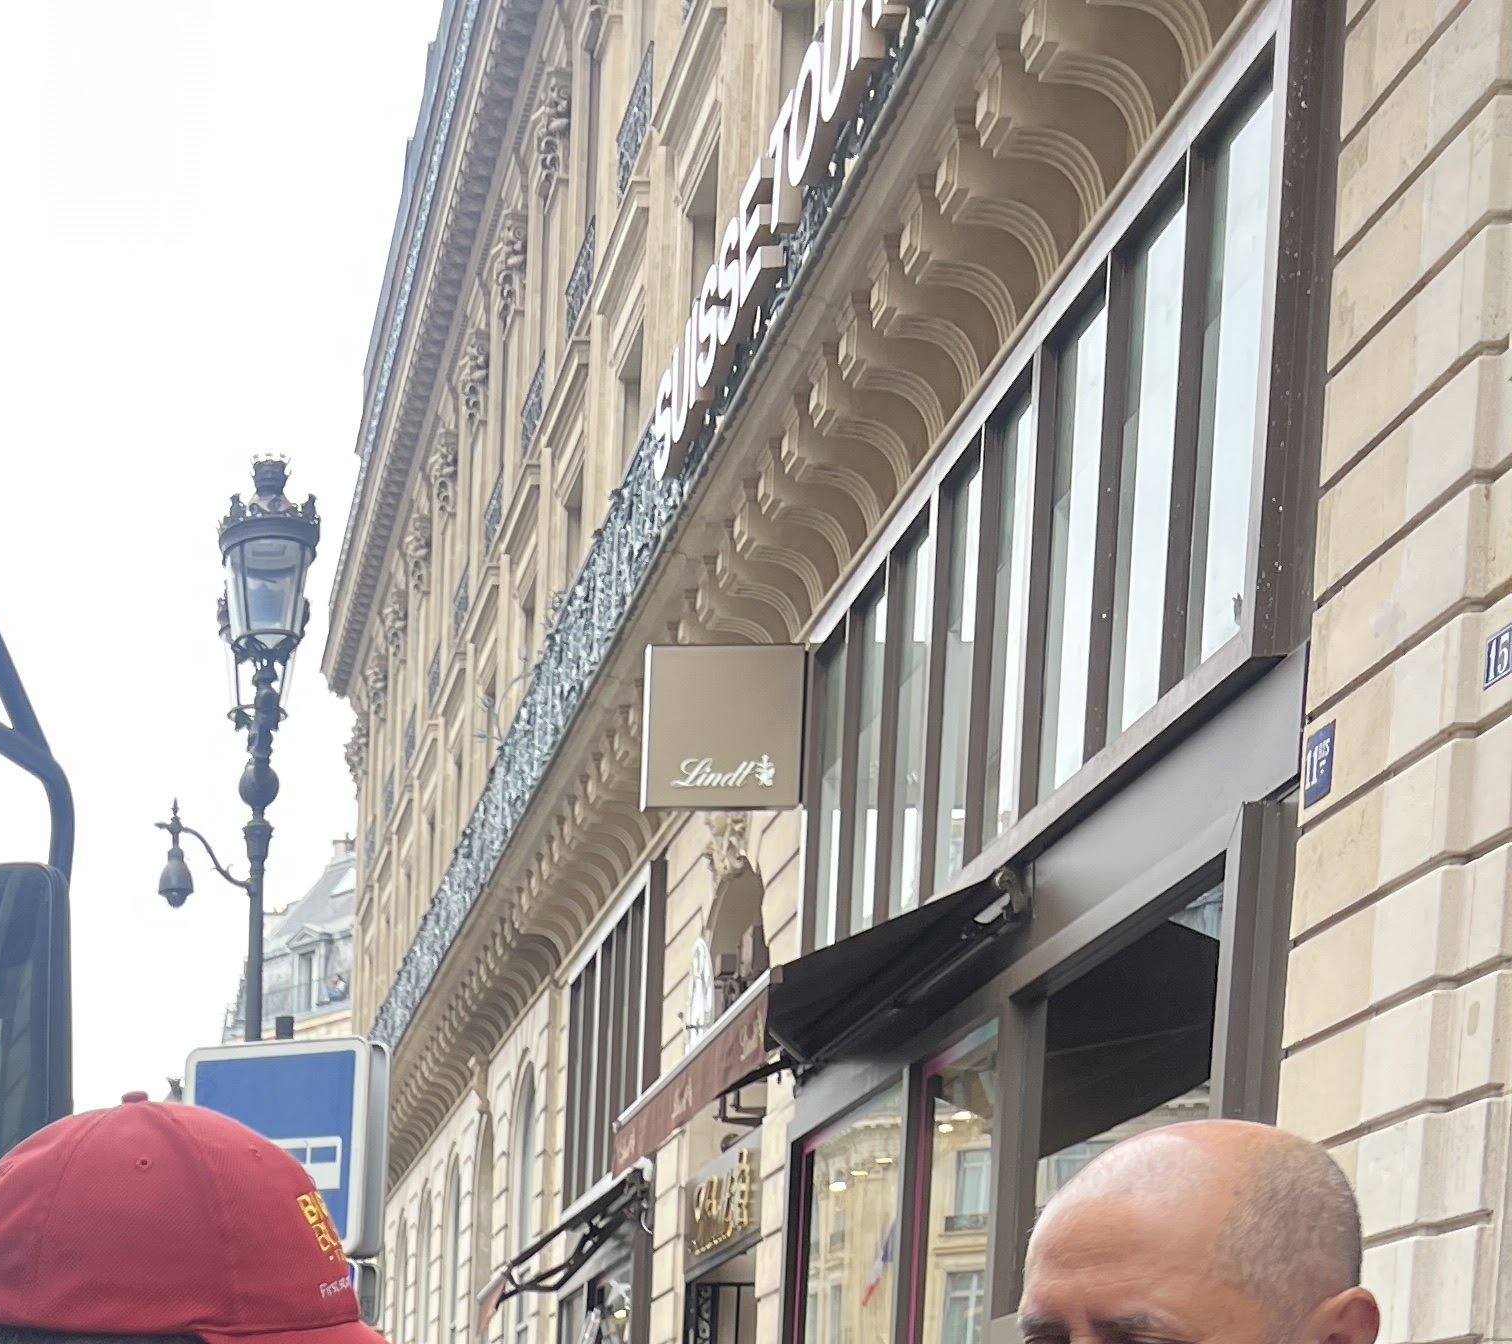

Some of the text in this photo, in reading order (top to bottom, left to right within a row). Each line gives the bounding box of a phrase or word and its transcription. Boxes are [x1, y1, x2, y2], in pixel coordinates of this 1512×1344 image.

[653, 156, 776, 482] SUISSE
[1487, 631, 1510, 681] 15
[670, 757, 756, 788] Lindt
[312, 1221, 341, 1251] BU
